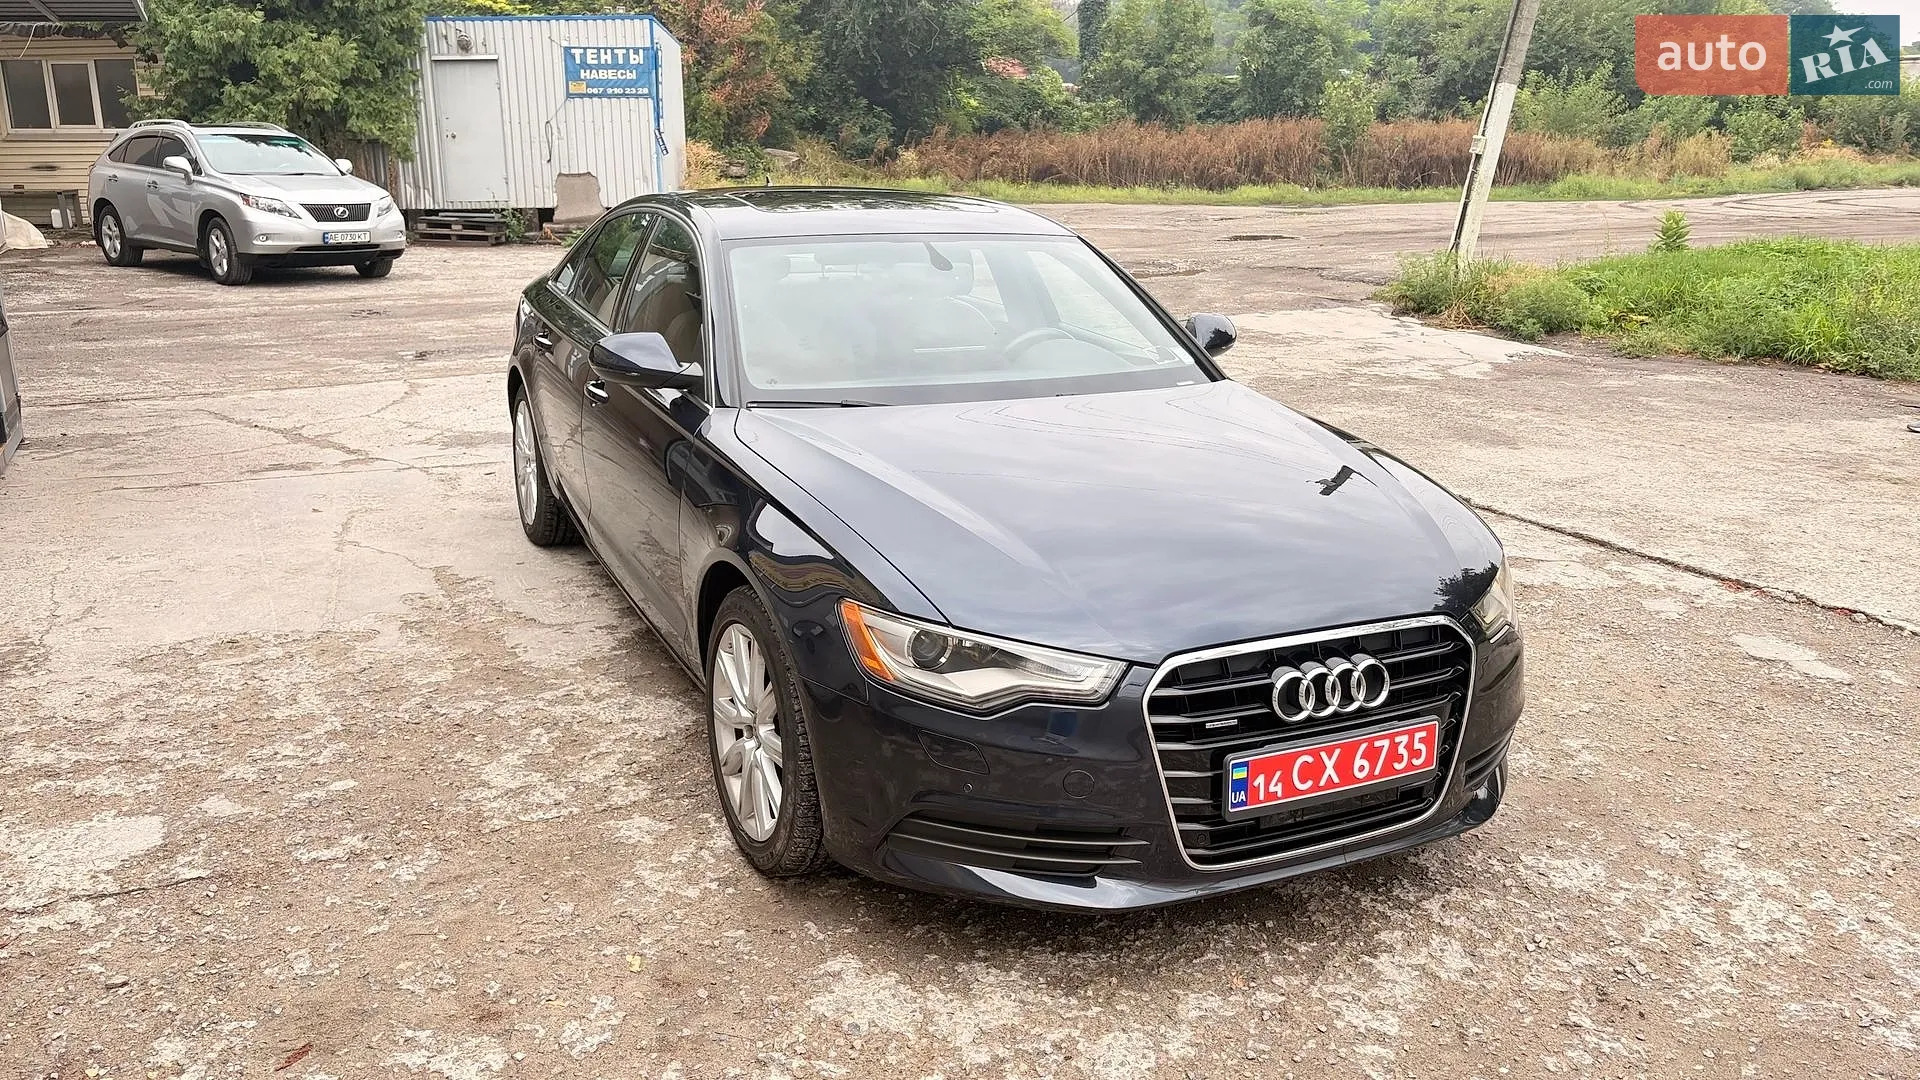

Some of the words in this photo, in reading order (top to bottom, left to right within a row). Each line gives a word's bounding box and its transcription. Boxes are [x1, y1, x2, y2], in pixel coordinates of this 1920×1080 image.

[571, 48, 644, 65] ТЕНТЫ
[580, 69, 637, 80] НАВЕСЫ
[329, 233, 340, 241] AE
[1252, 771, 1284, 801] 14
[1292, 748, 1341, 791] CX
[1352, 731, 1429, 779] 6735
[1231, 791, 1247, 804] UA
